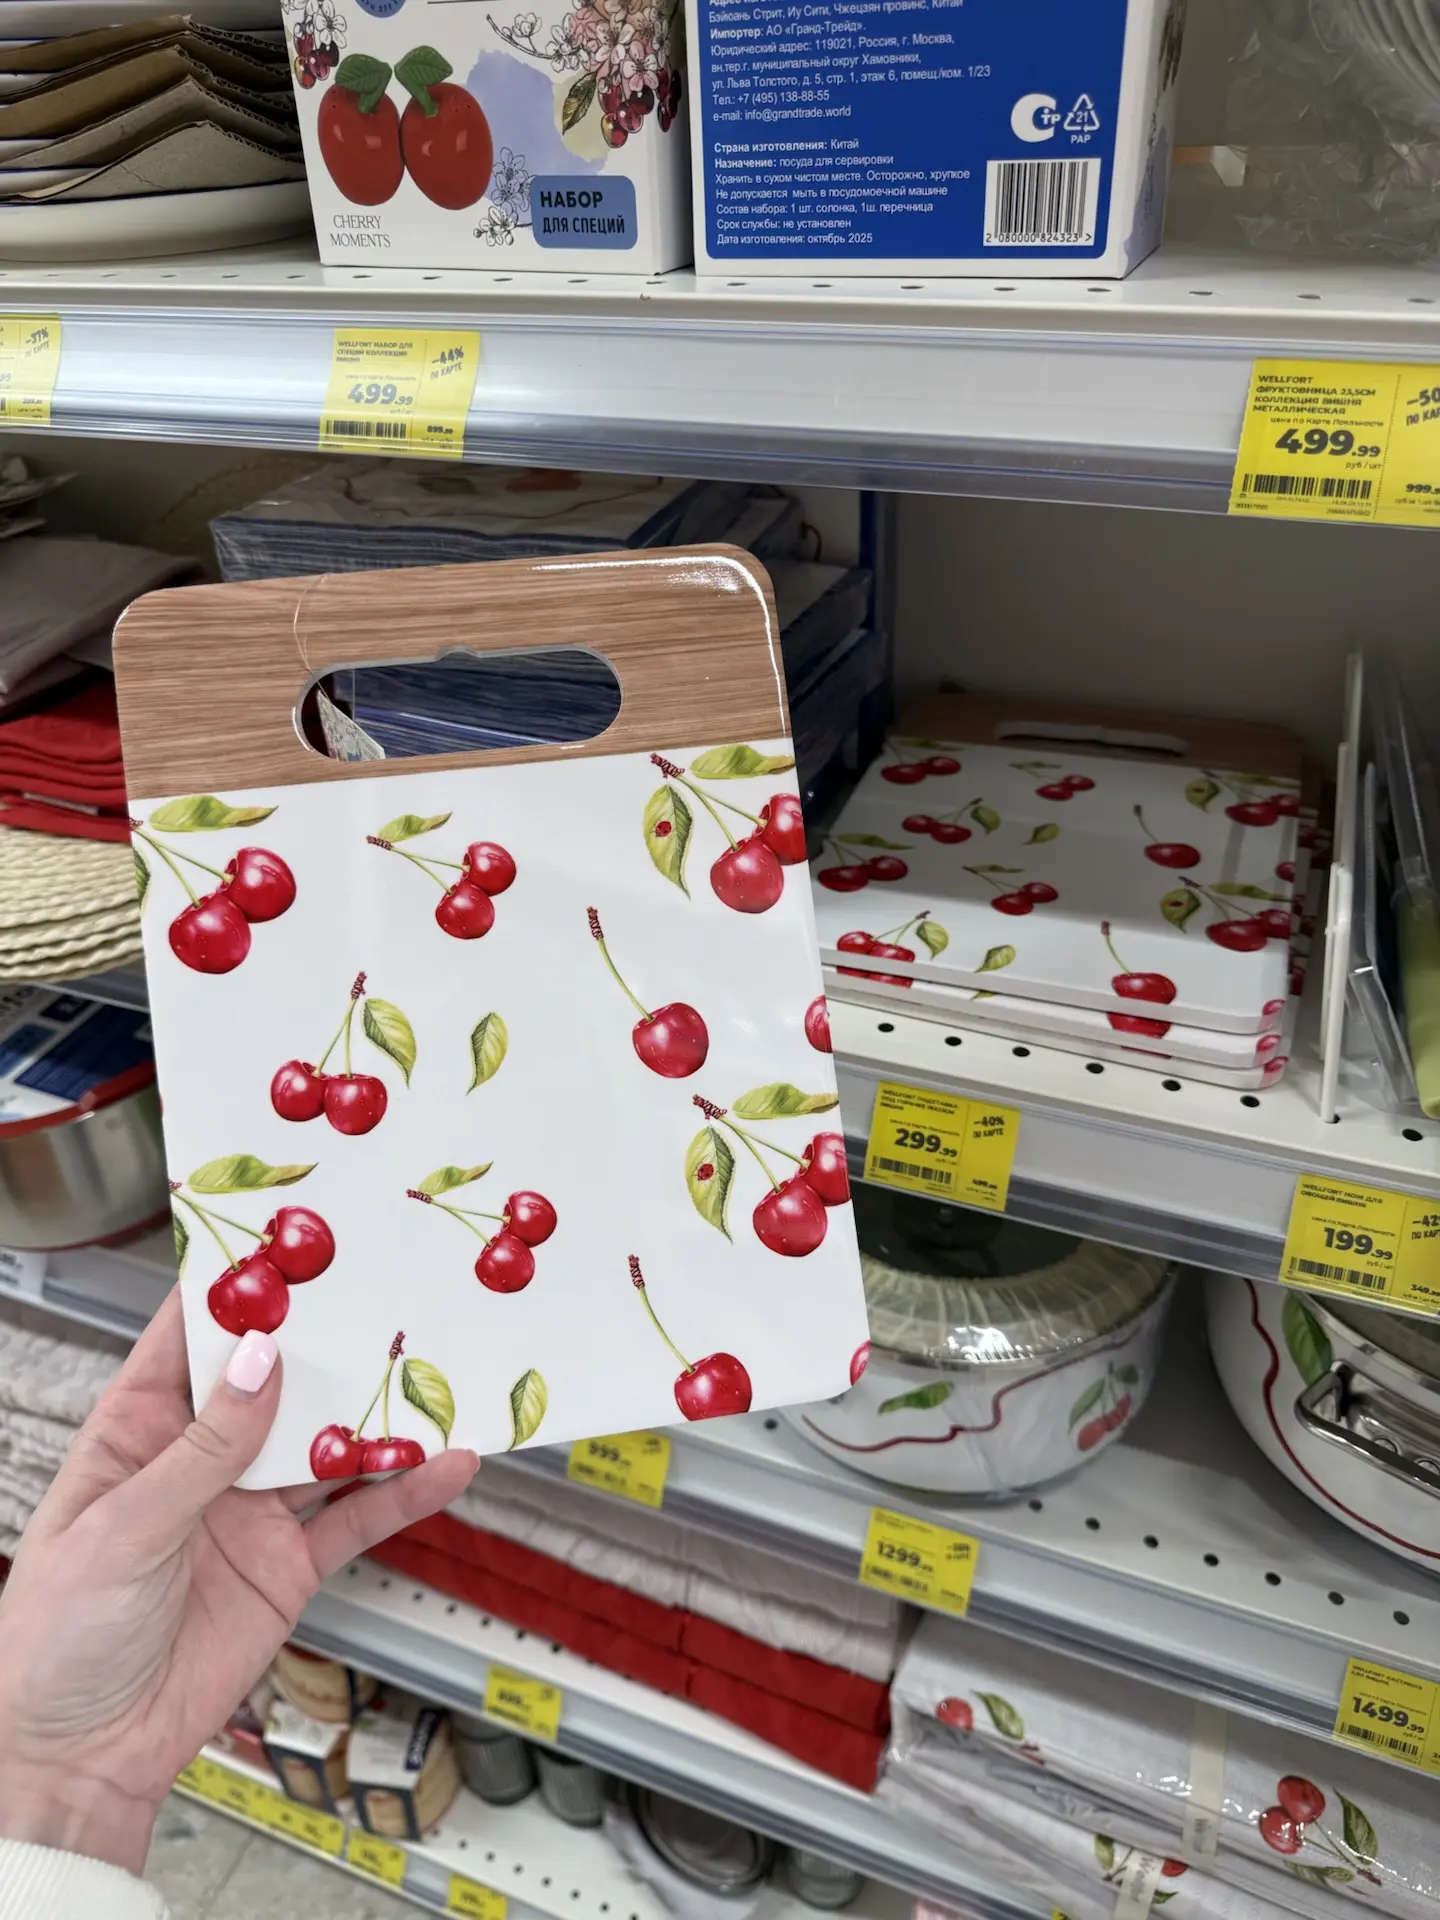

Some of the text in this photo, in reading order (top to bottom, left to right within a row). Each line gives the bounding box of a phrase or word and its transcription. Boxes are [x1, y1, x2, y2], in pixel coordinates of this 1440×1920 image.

[709, 11, 751, 23] Бэйюань
[753, 8, 785, 21] Стрит,
[788, 6, 801, 19] Иу
[804, 4, 831, 17] Сити,
[833, 3, 881, 15] Чжецзян
[710, 27, 764, 40] Импортер:
[766, 24, 782, 36] АО
[711, 42, 777, 57] Юридический
[778, 42, 812, 55] адрес:
[815, 37, 856, 50] 119021,
[858, 36, 900, 48] Россия,
[912, 33, 955, 45] Москва,
[752, 57, 830, 73] муниципальный
[832, 56, 859, 69] округ
[862, 52, 922, 65] Хамовники,
[727, 77, 751, 89] Льва
[752, 75, 800, 88] Толстого,
[826, 73, 847, 86] стр.
[861, 71, 886, 83] этаж
[968, 64, 991, 78] 1/23
[738, 93, 750, 104] +7
[752, 92, 778, 106] (495)
[780, 89, 830, 103] 138-88-55
[713, 105, 852, 122] e-mail: info@grandtrade.world
[1076, 112, 1089, 123] 21
[714, 138, 860, 155] Страна изготовления: Китай
[1071, 134, 1092, 144] PAP
[714, 155, 895, 170] Назначение: посуда для сервировки
[715, 169, 971, 186] Хранить в сухом чистом месте. Осторожно, хрупкое
[540, 191, 604, 208] НАБОР
[716, 186, 948, 201] Не допускается мыть в посудомоечной машине
[716, 204, 749, 214] Состав
[751, 203, 788, 215] набора:
[816, 204, 858, 213] солонка,
[879, 202, 934, 214] перечница
[333, 214, 381, 229] CHERRY
[543, 214, 625, 235] ДЛЯ СПЕЦИЙ
[717, 218, 852, 231] Срок службы: не установлен
[330, 232, 391, 247] MOMENTS
[717, 232, 873, 245] Дата изготовления: октябрь 2025
[1258, 375, 1313, 384] WELLFORT
[1256, 386, 1337, 396] ФРУКТОВНИЦА
[1254, 396, 1319, 406] КОЛЛЕКЦИЯ
[1253, 405, 1345, 415] МЕТАЛЛИЧЕСКАЯ
[1275, 428, 1381, 457] 499.99
[1412, 1214, 1440, 1227] -42
[1324, 1227, 1393, 1260] 199.99
